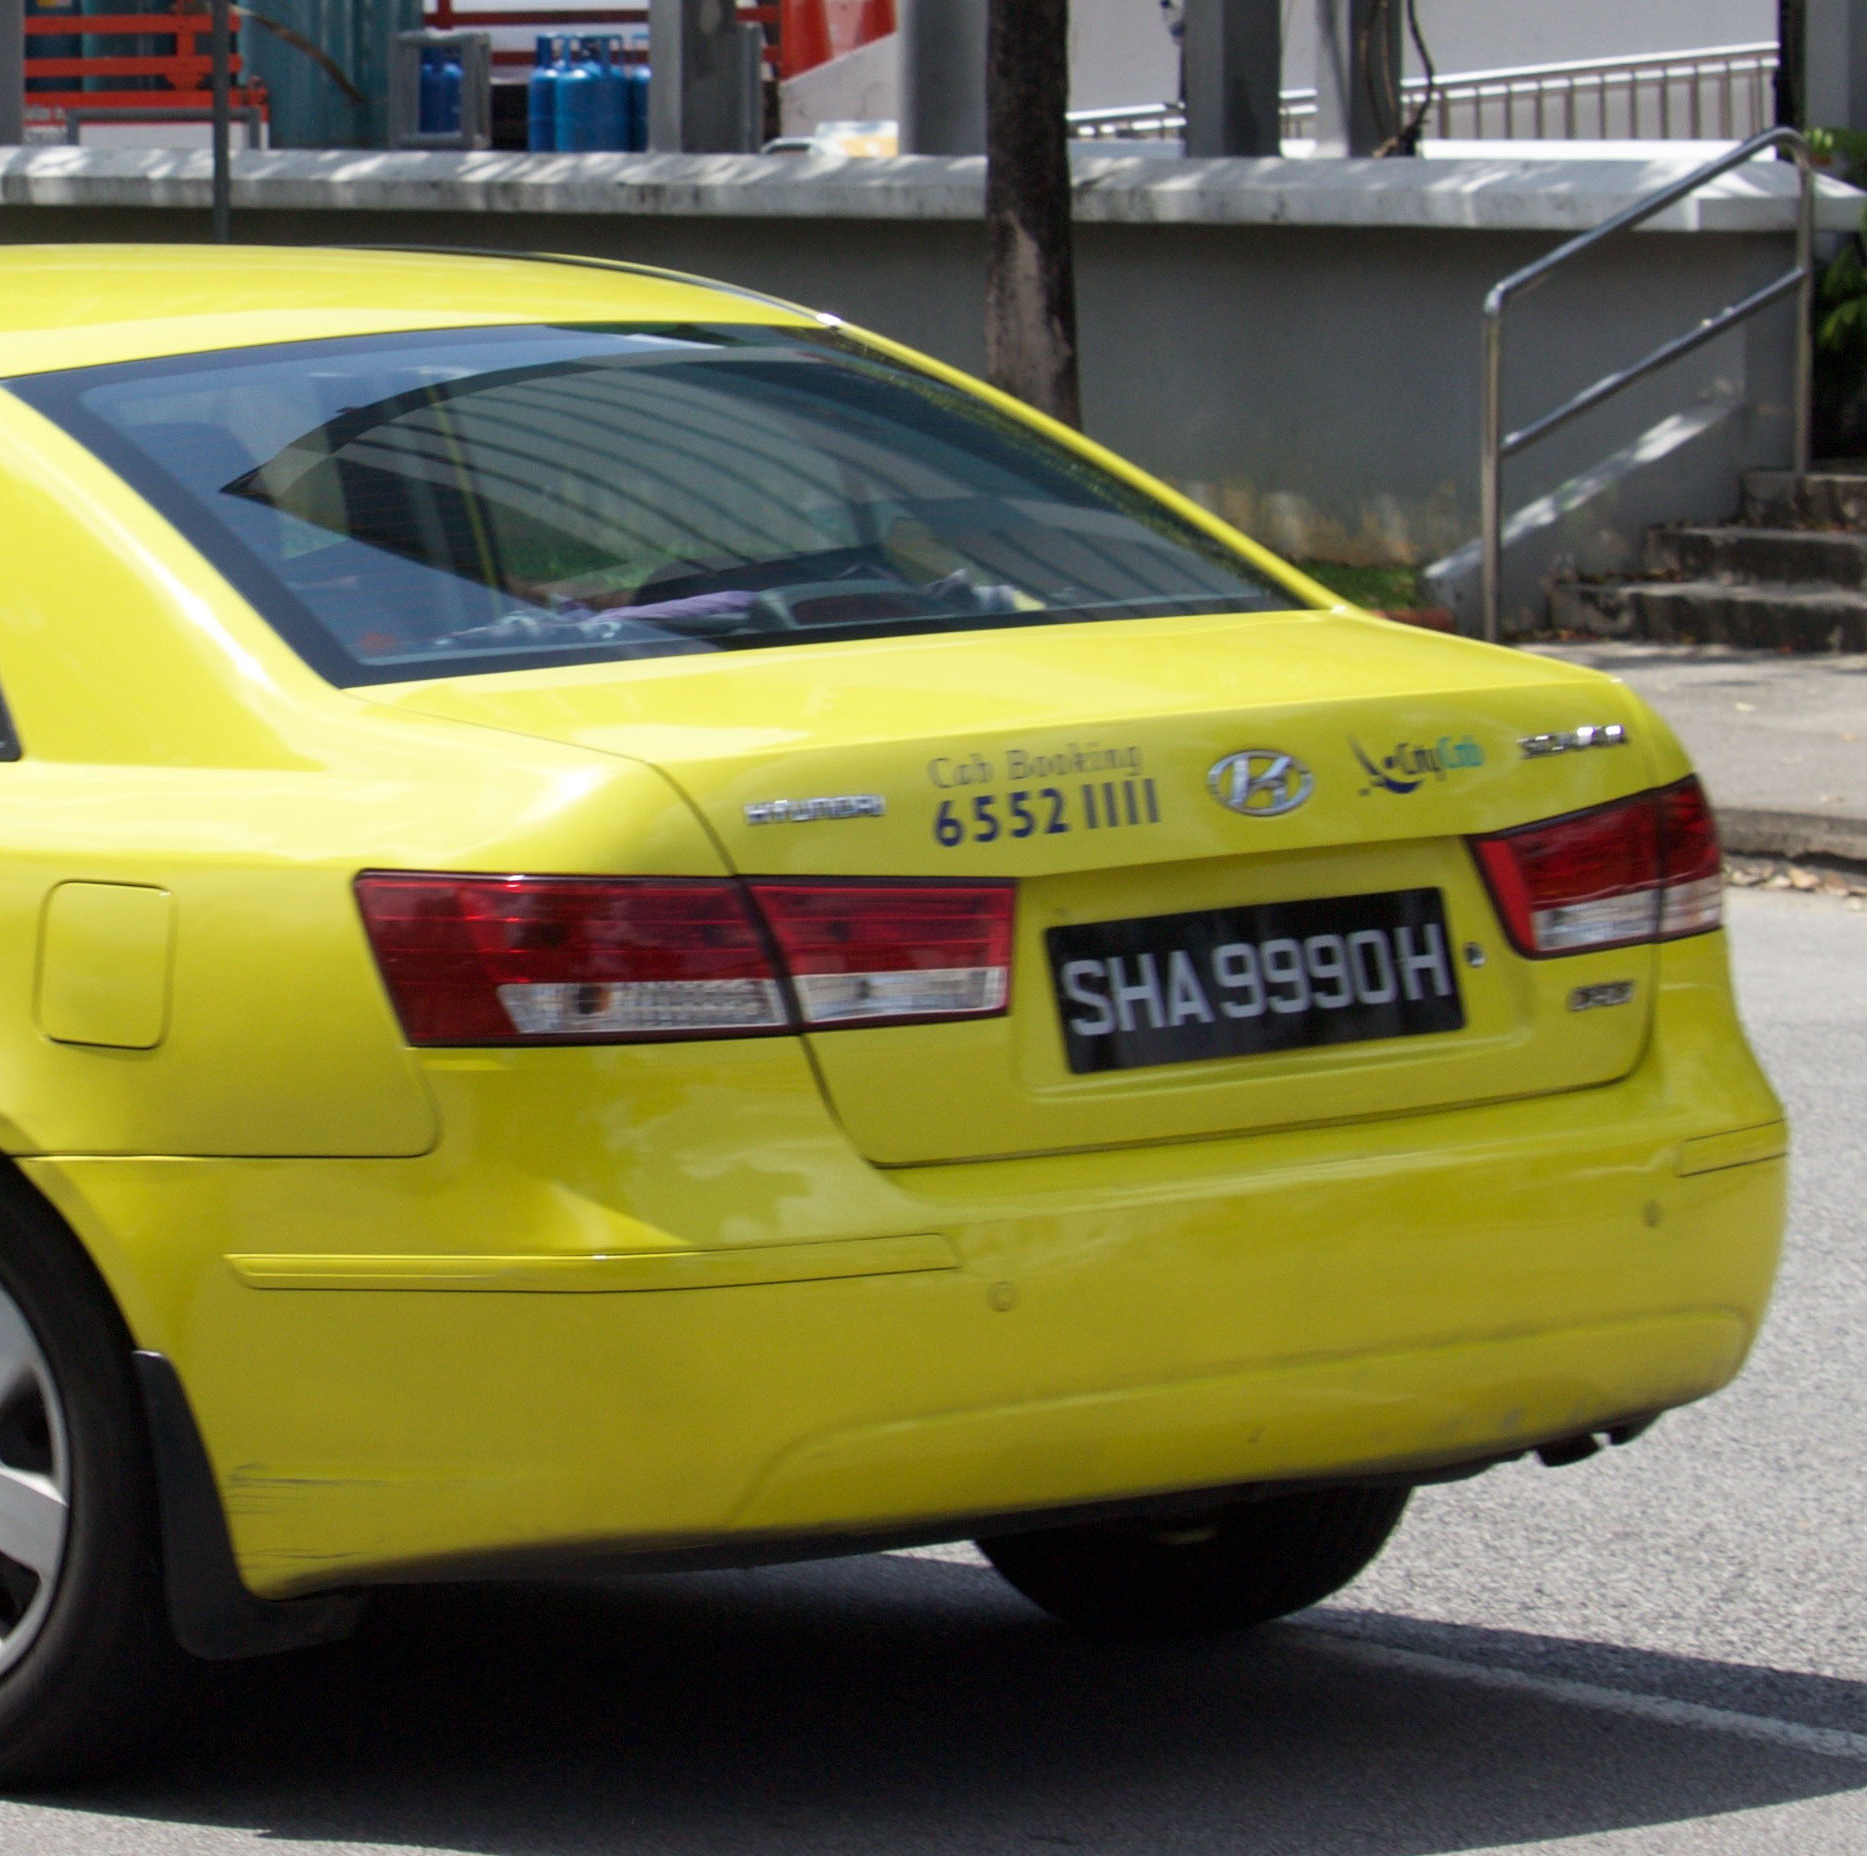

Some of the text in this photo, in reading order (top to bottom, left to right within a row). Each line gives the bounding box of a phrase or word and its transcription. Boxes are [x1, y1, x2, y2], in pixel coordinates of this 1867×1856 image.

[928, 742, 1144, 789] Cab Booking
[1394, 736, 1485, 782] CityCab
[935, 778, 1162, 848] 6552 1111
